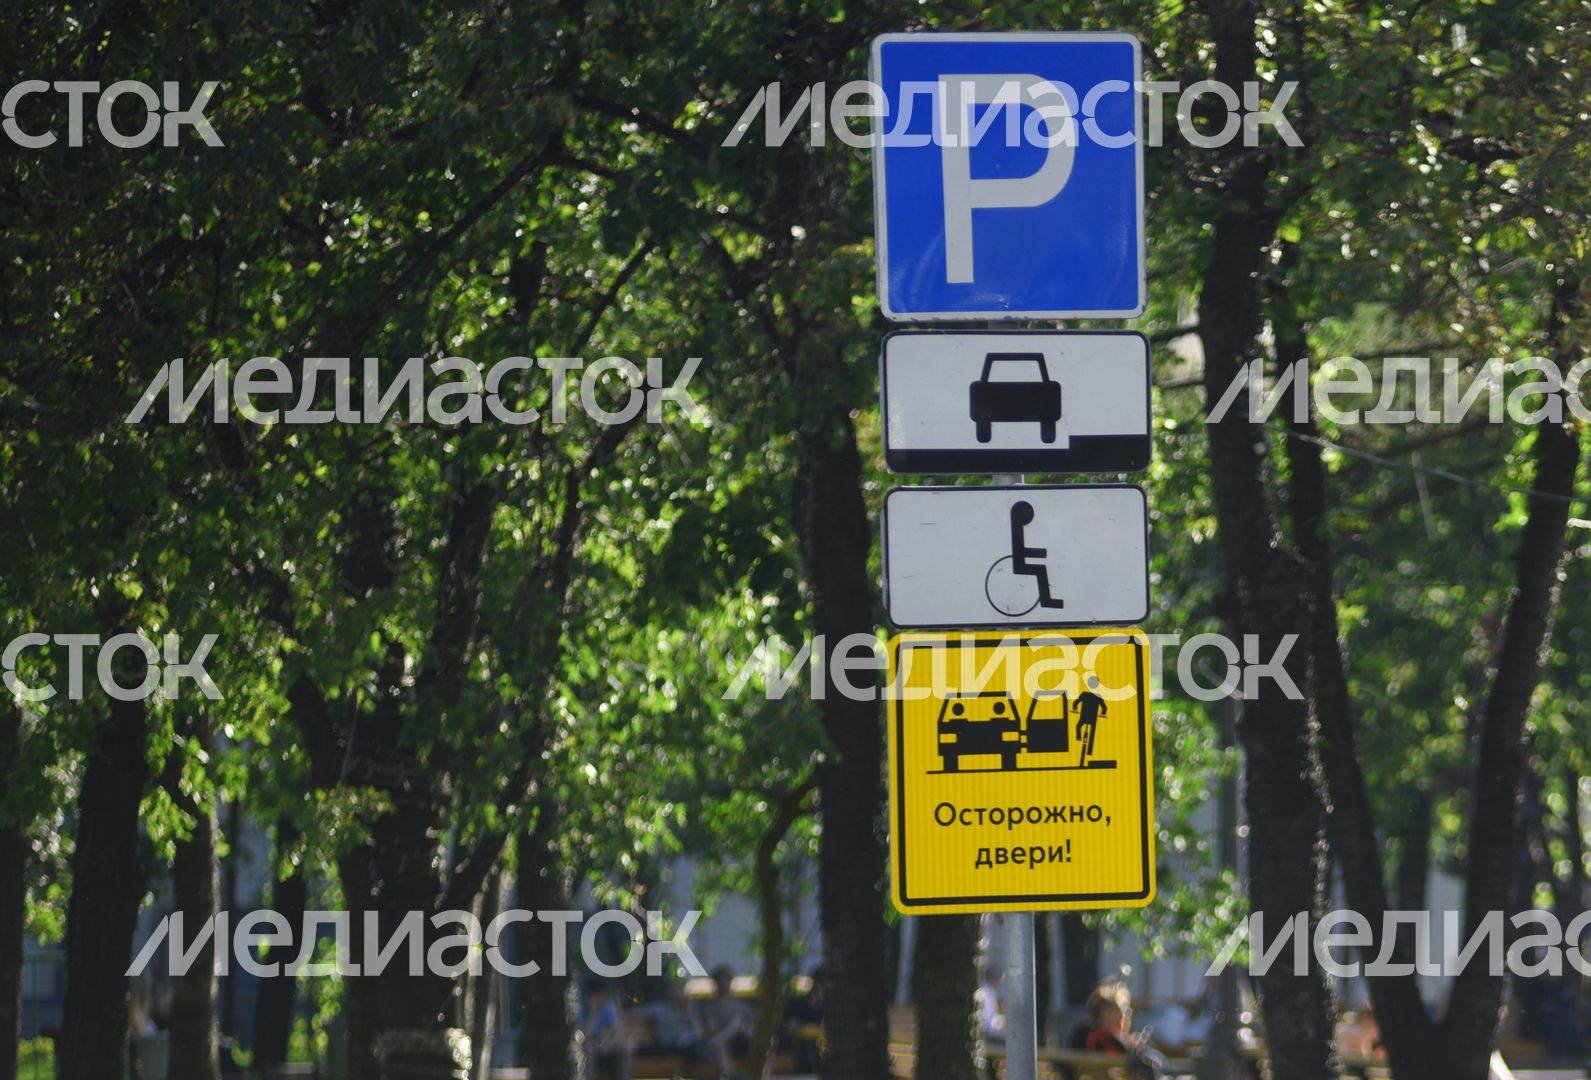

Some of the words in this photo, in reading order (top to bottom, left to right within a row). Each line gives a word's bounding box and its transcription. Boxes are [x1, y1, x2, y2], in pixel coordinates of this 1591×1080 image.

[938, 74, 1075, 284] P
[934, 801, 1111, 830] Осторожно,
[974, 839, 1072, 869] двери!
